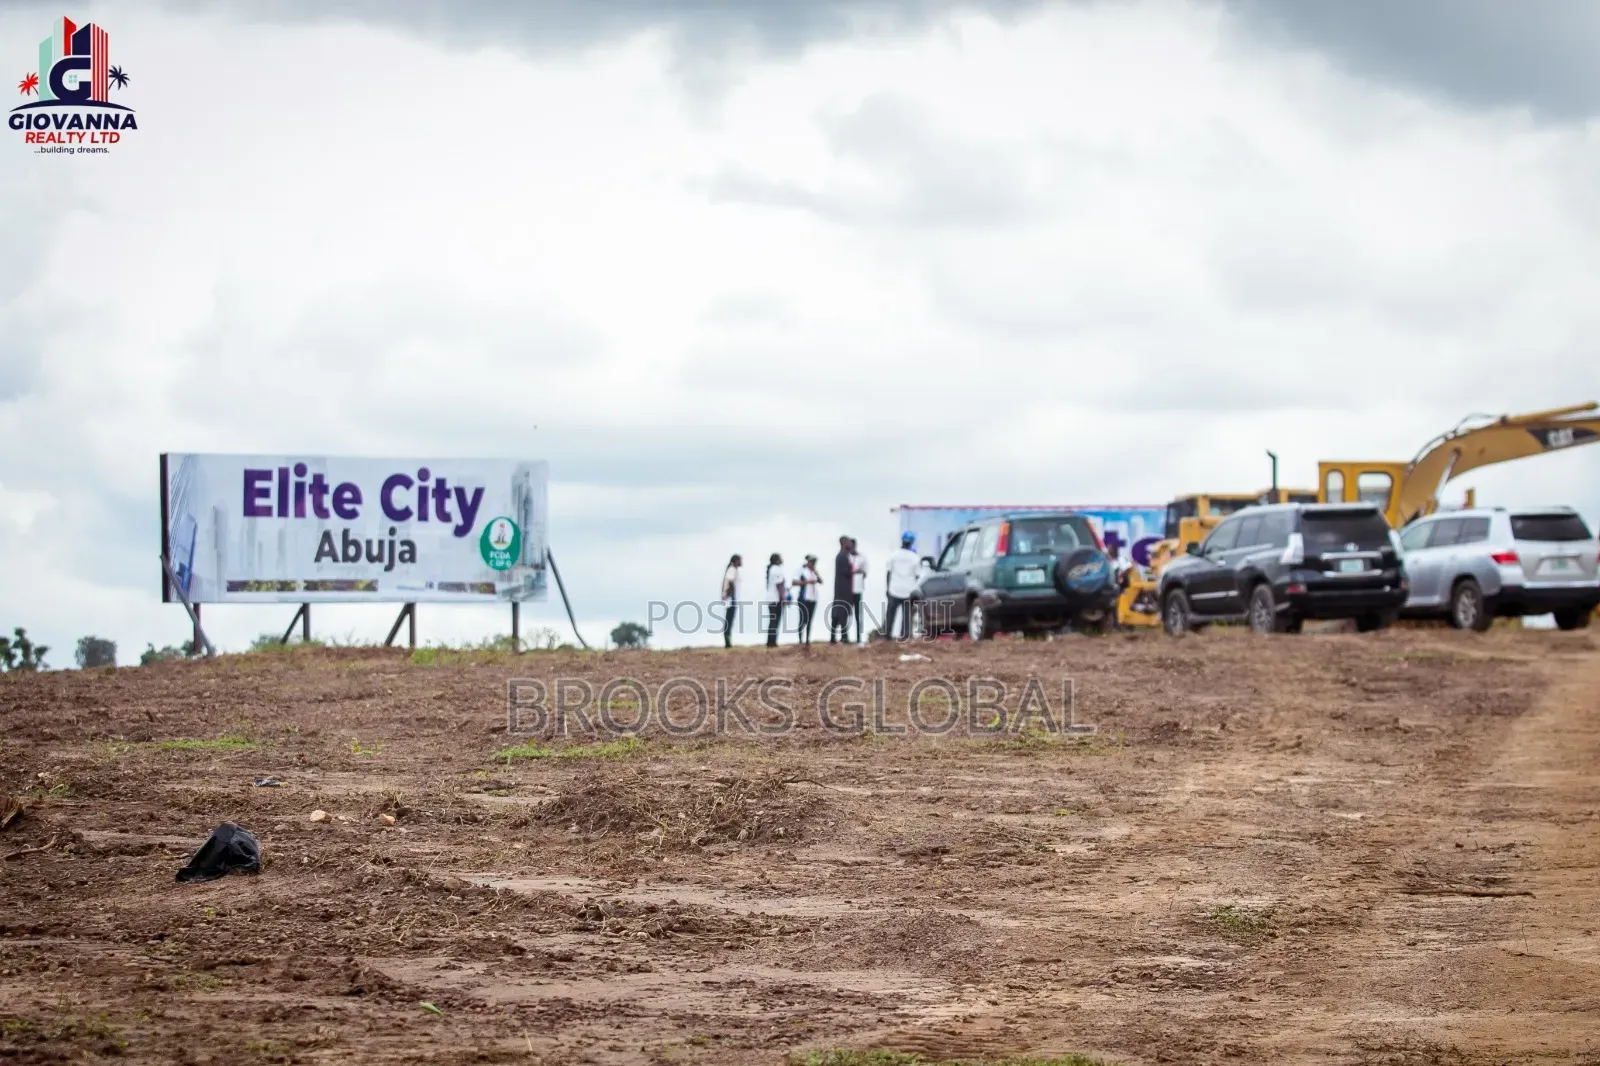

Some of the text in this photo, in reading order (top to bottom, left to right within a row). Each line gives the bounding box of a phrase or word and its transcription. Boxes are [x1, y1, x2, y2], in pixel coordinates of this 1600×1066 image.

[242, 462, 486, 538] Elite City
[314, 527, 418, 571] Abuja
